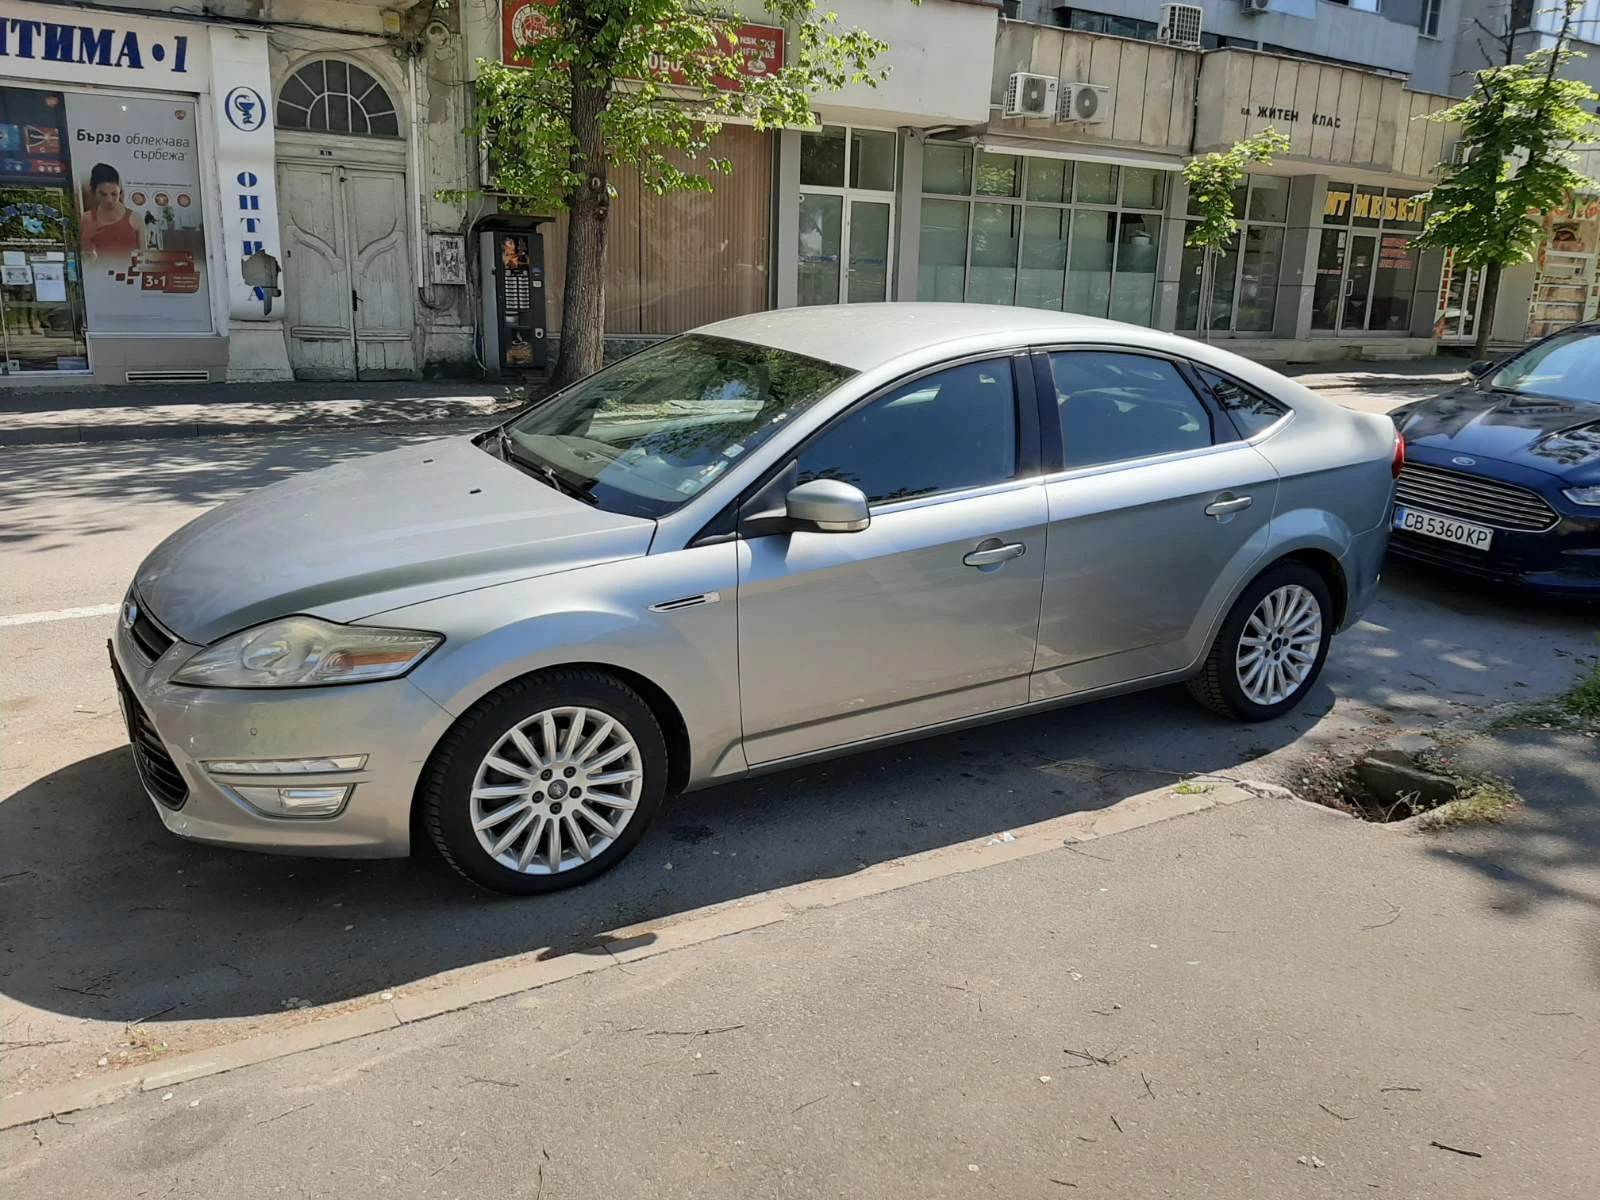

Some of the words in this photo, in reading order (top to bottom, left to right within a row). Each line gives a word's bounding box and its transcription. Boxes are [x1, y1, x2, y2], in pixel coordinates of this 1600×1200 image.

[1257, 106, 1299, 122] ЖИТЕН
[1311, 113, 1342, 128] КЛАС
[76, 128, 121, 145] Бързо
[126, 133, 190, 148] облекчава
[237, 171, 265, 301] ОПТИА
[1404, 512, 1424, 530] CB
[1426, 518, 1465, 541] 5360
[1466, 527, 1488, 545] KP
